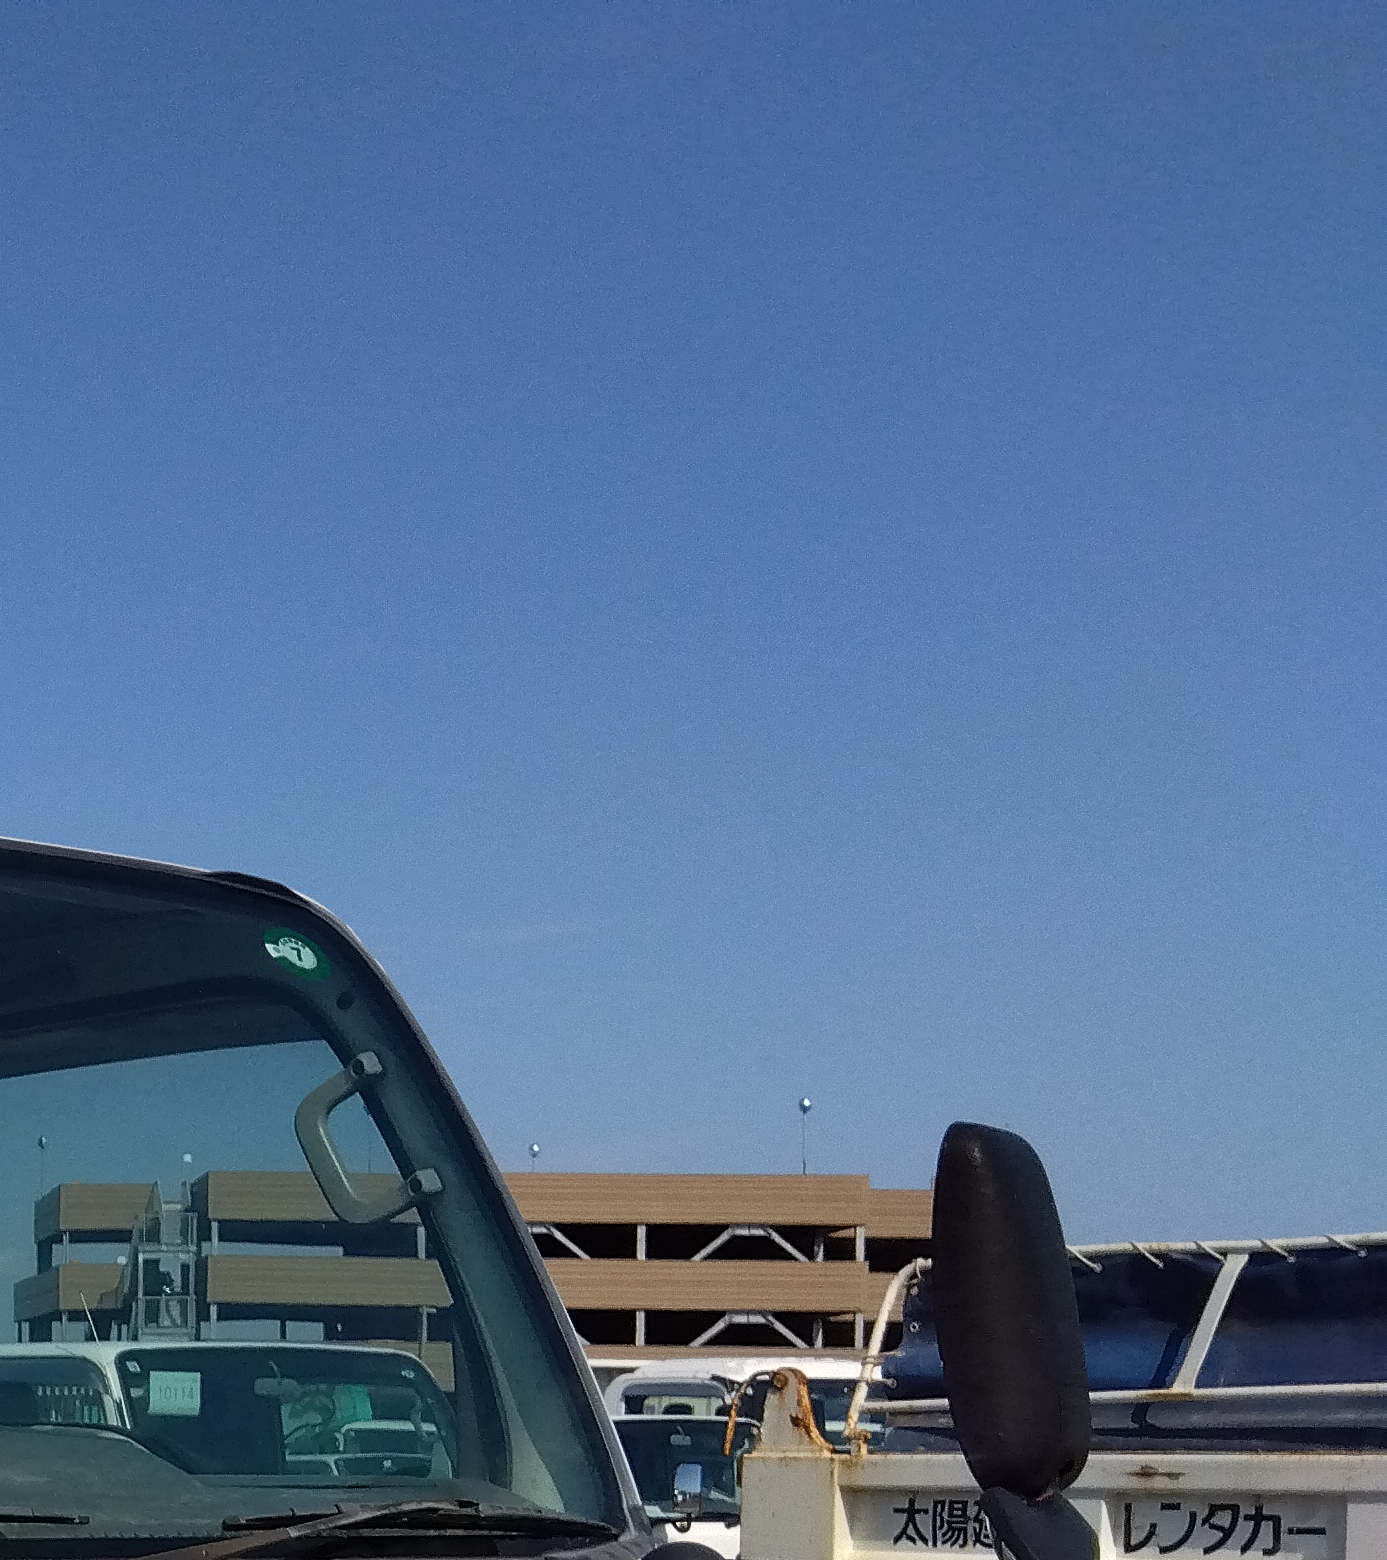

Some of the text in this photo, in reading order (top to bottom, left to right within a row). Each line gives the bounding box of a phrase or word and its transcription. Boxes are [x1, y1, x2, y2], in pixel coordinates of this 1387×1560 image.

[1124, 1502, 1326, 1556] レンタカー
